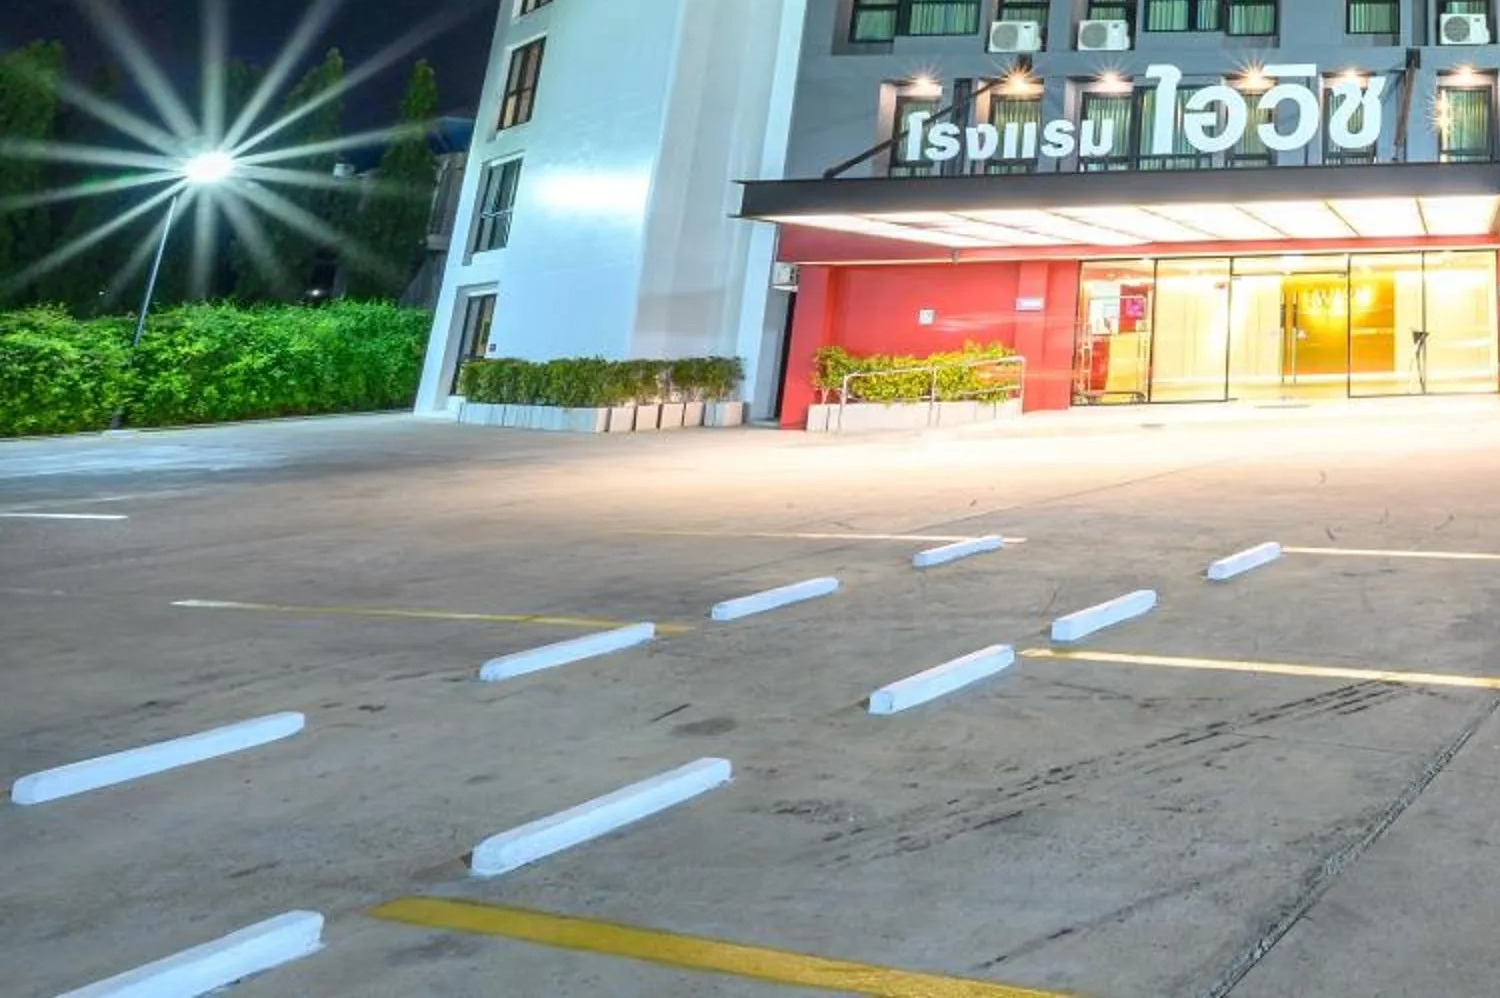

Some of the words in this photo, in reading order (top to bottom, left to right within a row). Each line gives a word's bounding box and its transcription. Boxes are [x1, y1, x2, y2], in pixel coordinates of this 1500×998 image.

[905, 110, 1115, 163] โรงแรม
[1145, 63, 1387, 156] ไอวิช
